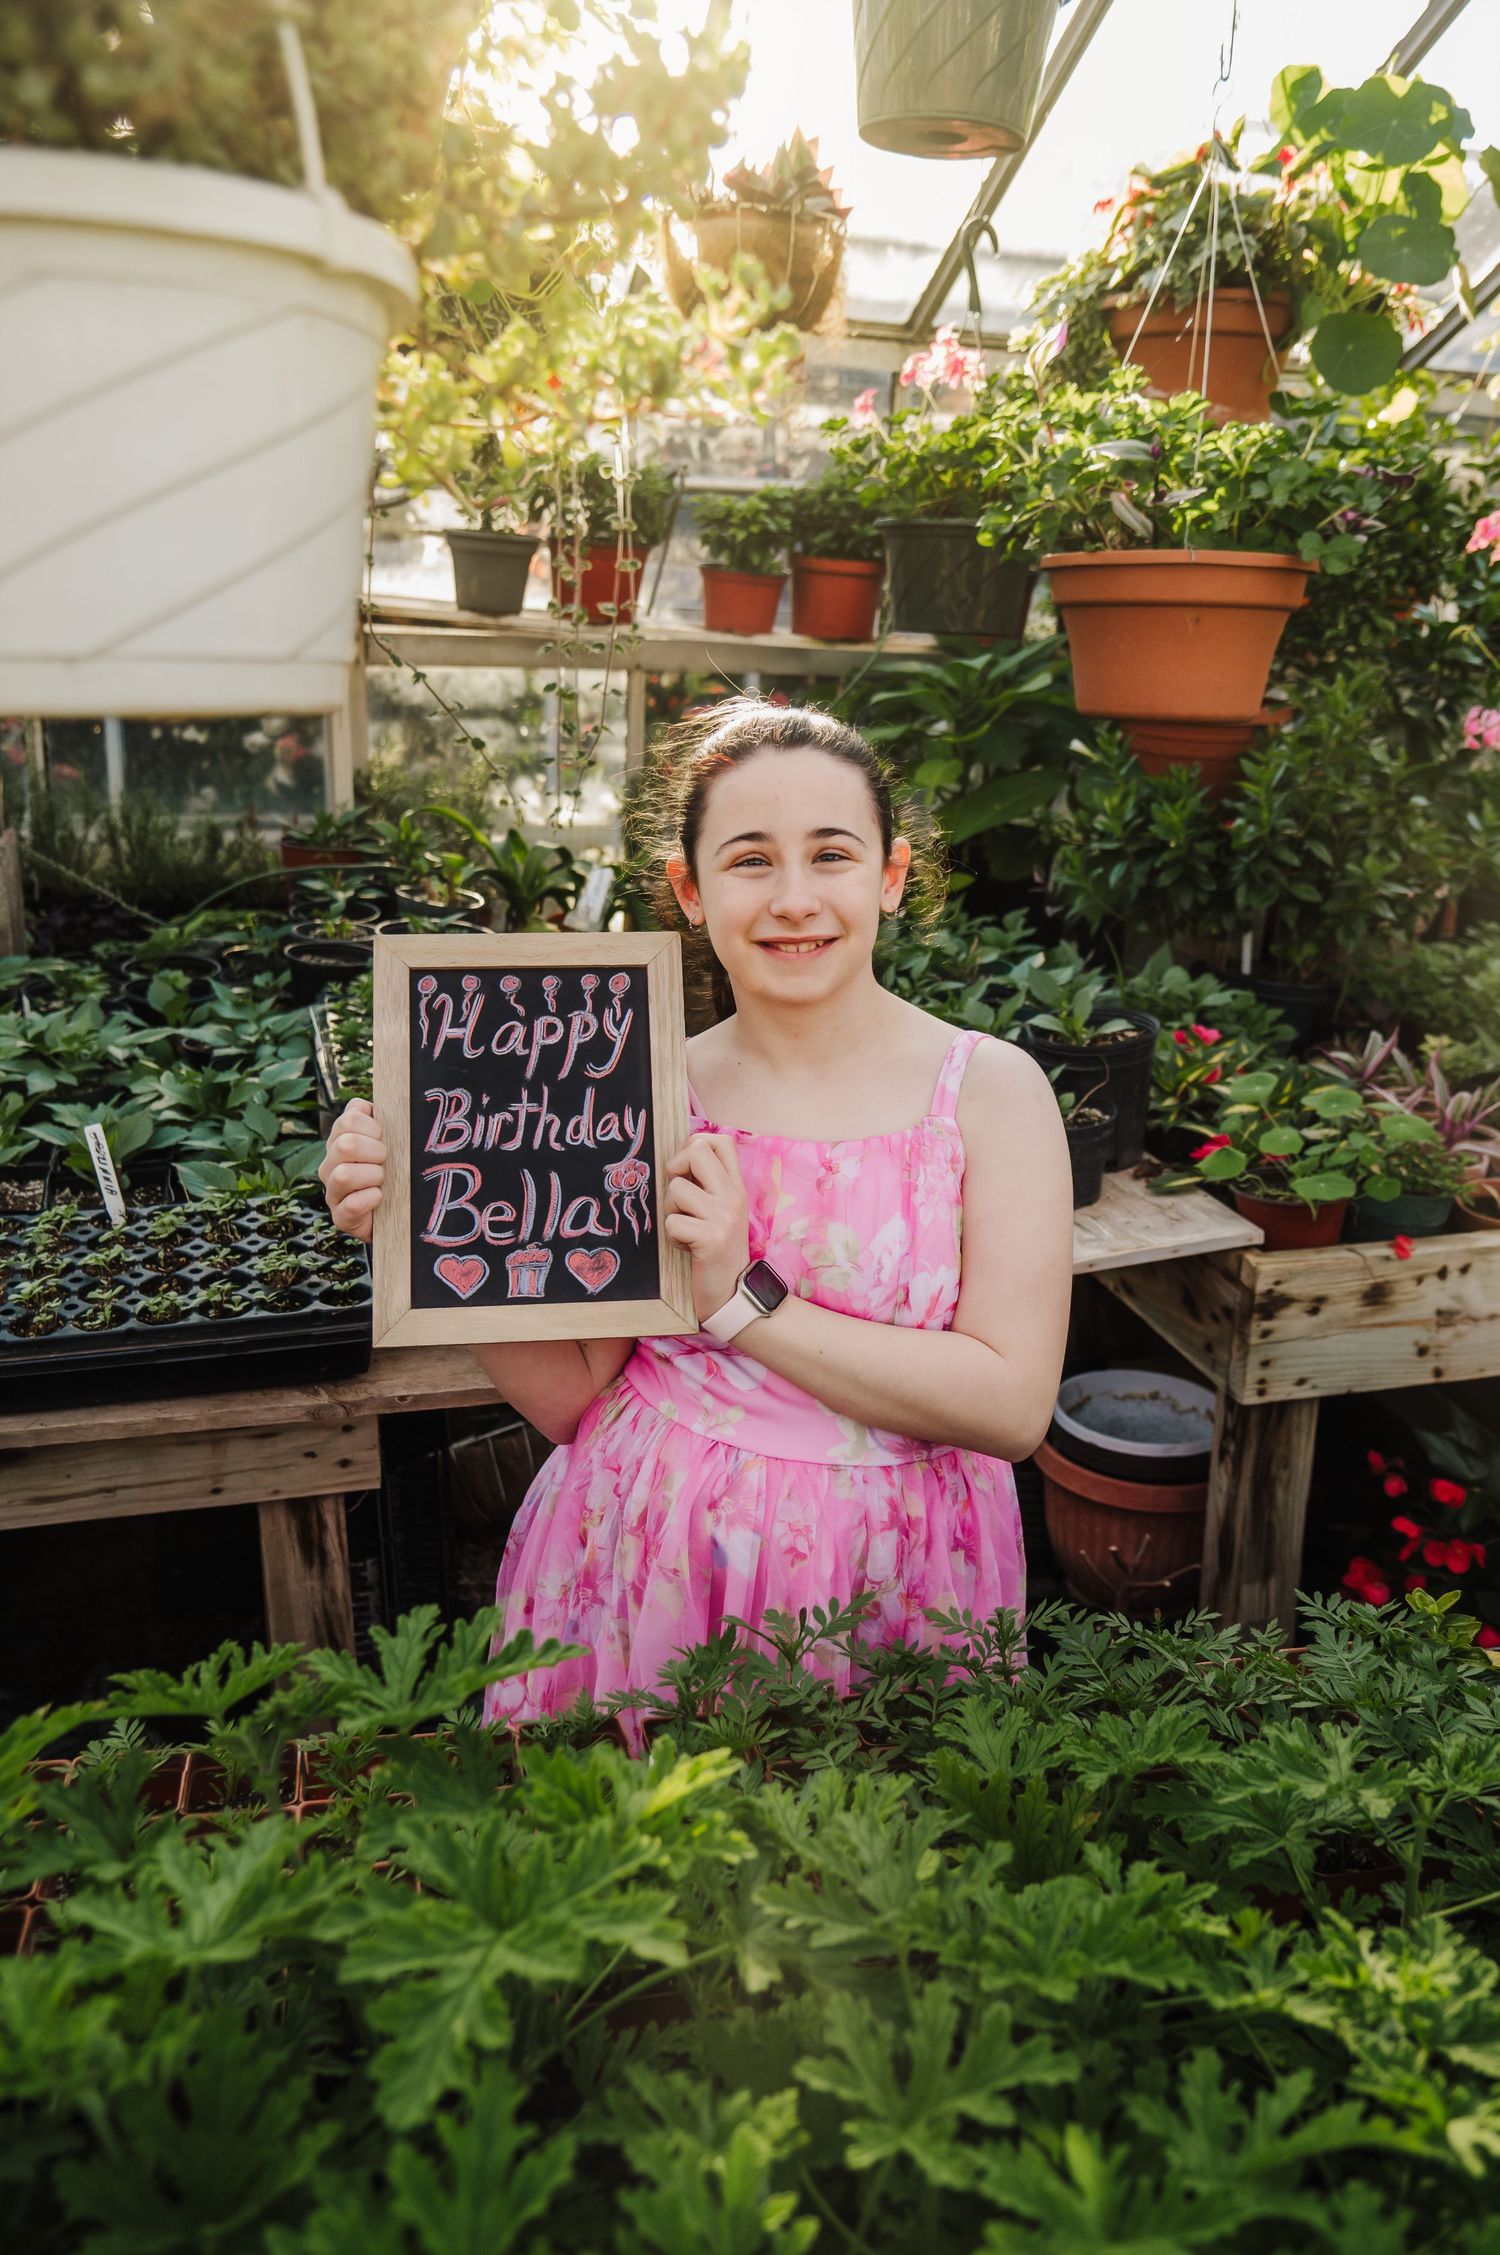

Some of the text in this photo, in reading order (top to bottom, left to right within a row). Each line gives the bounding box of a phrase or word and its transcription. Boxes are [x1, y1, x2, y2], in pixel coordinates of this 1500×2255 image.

[432, 992, 634, 1080] Happy
[424, 1084, 647, 1172] Birthday
[420, 1162, 616, 1246] Bella
